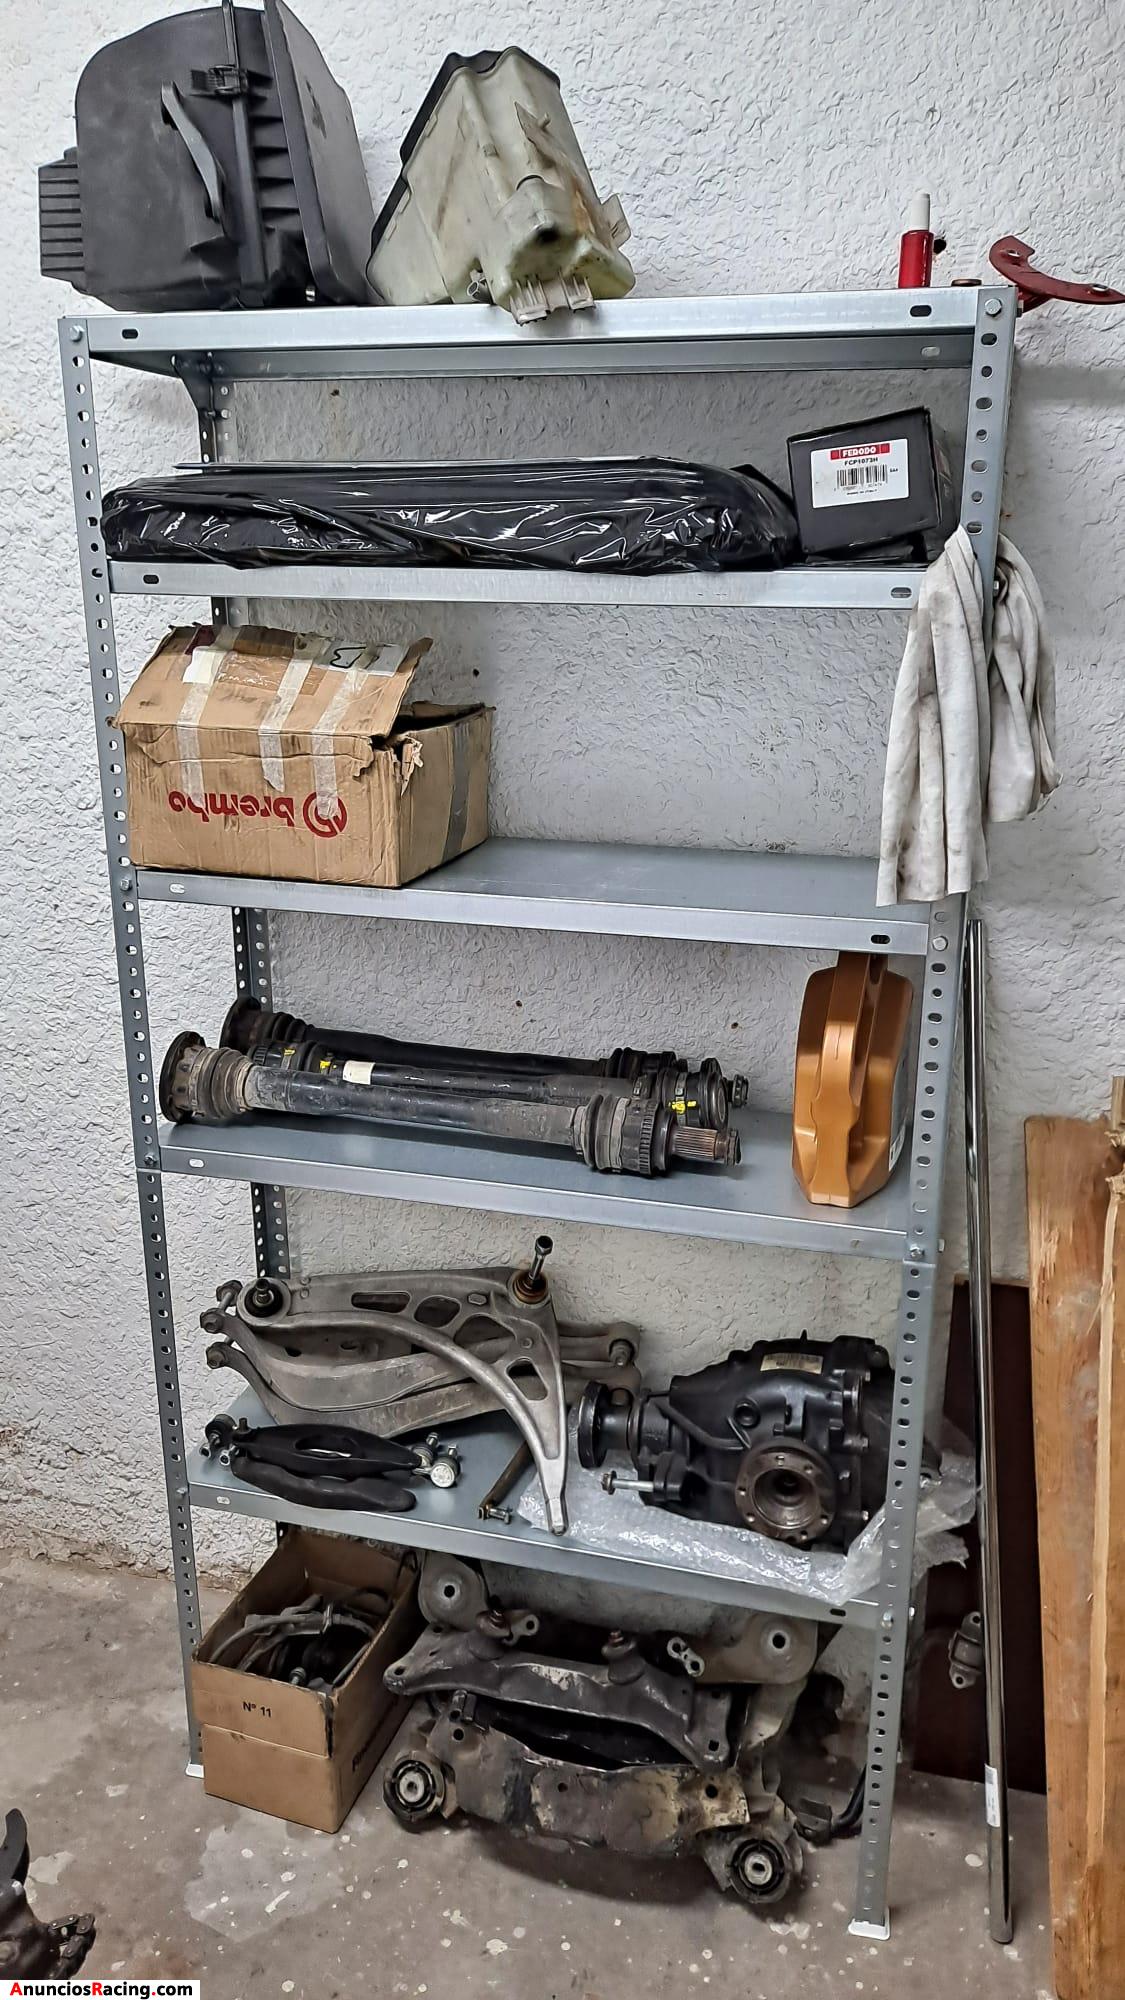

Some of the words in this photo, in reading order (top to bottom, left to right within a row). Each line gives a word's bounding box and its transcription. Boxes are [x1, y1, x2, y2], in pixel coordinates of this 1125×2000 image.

[842, 446, 877, 457] FERODO
[168, 790, 295, 827] brembo
[260, 1706, 272, 1718] 11
